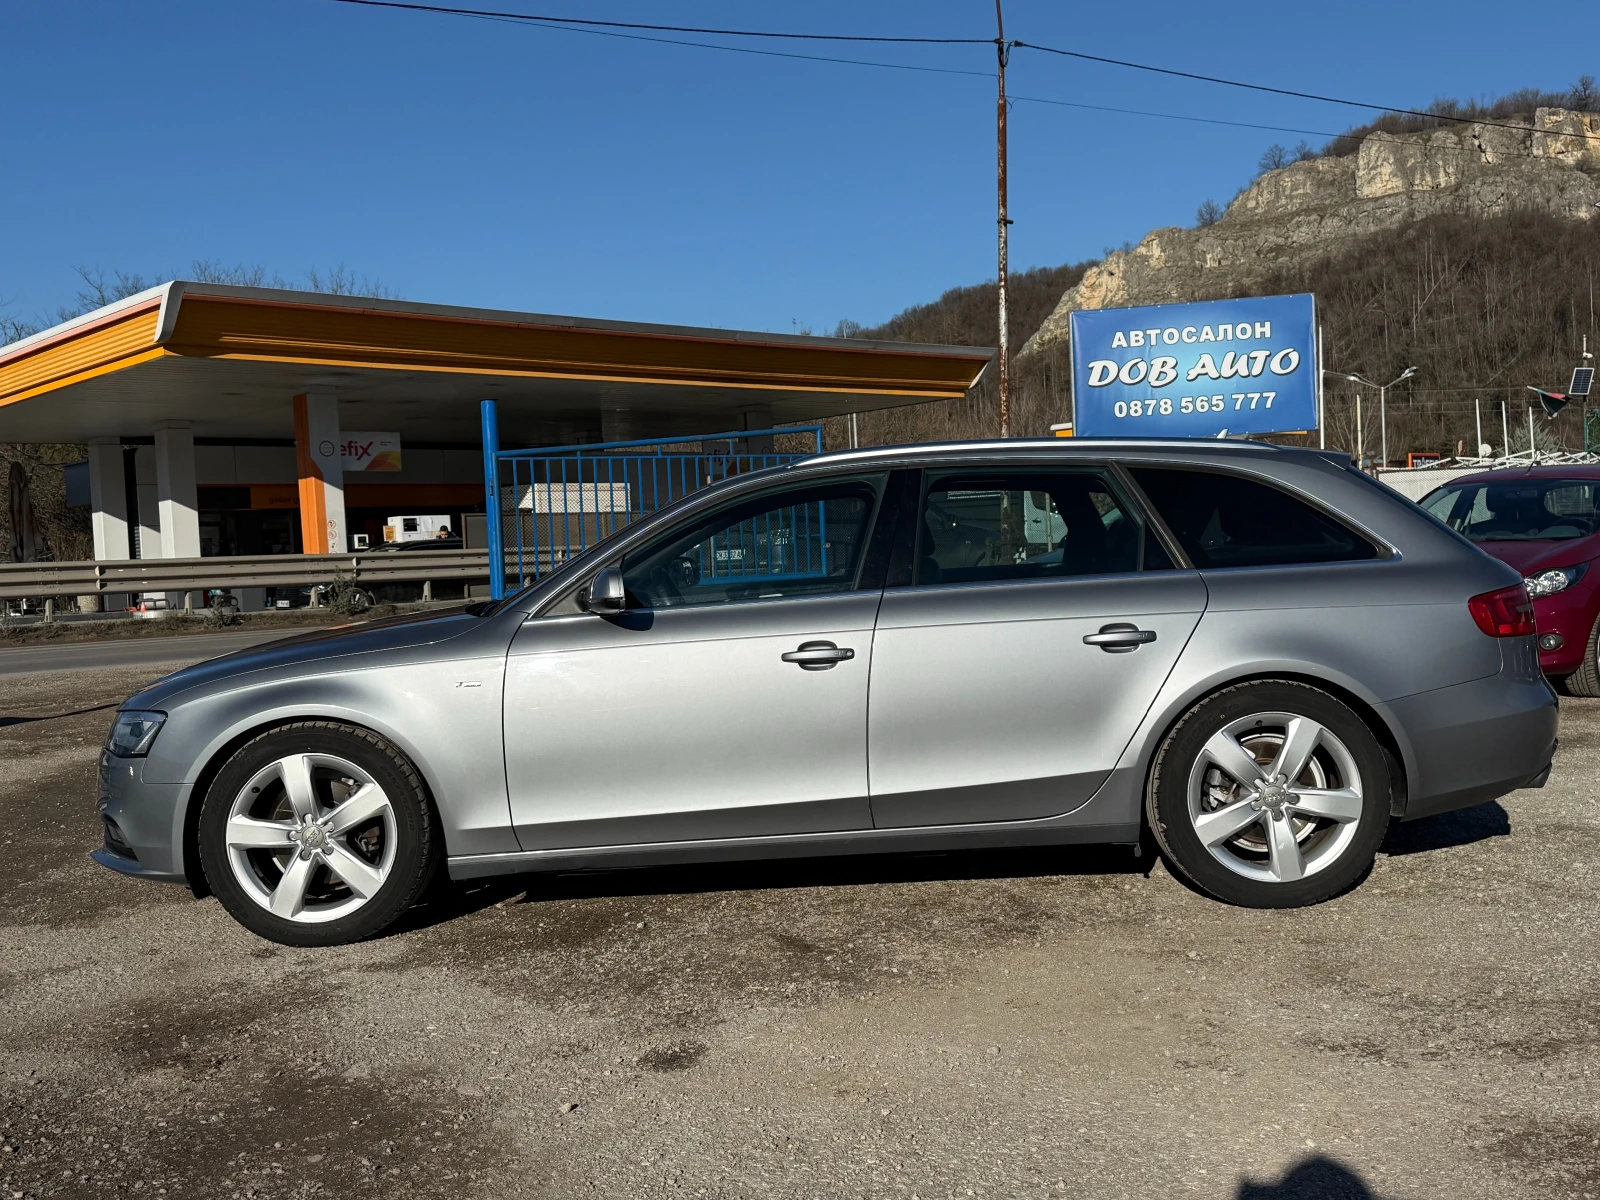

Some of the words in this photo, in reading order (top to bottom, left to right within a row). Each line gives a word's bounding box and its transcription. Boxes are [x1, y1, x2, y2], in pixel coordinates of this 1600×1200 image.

[1111, 321, 1272, 349] АВТОСАЛОН
[1087, 356, 1178, 388] DOB
[1186, 348, 1301, 381] AUTO
[1114, 398, 1173, 418] 0878
[1180, 395, 1225, 414] 565
[1232, 391, 1277, 411] 777
